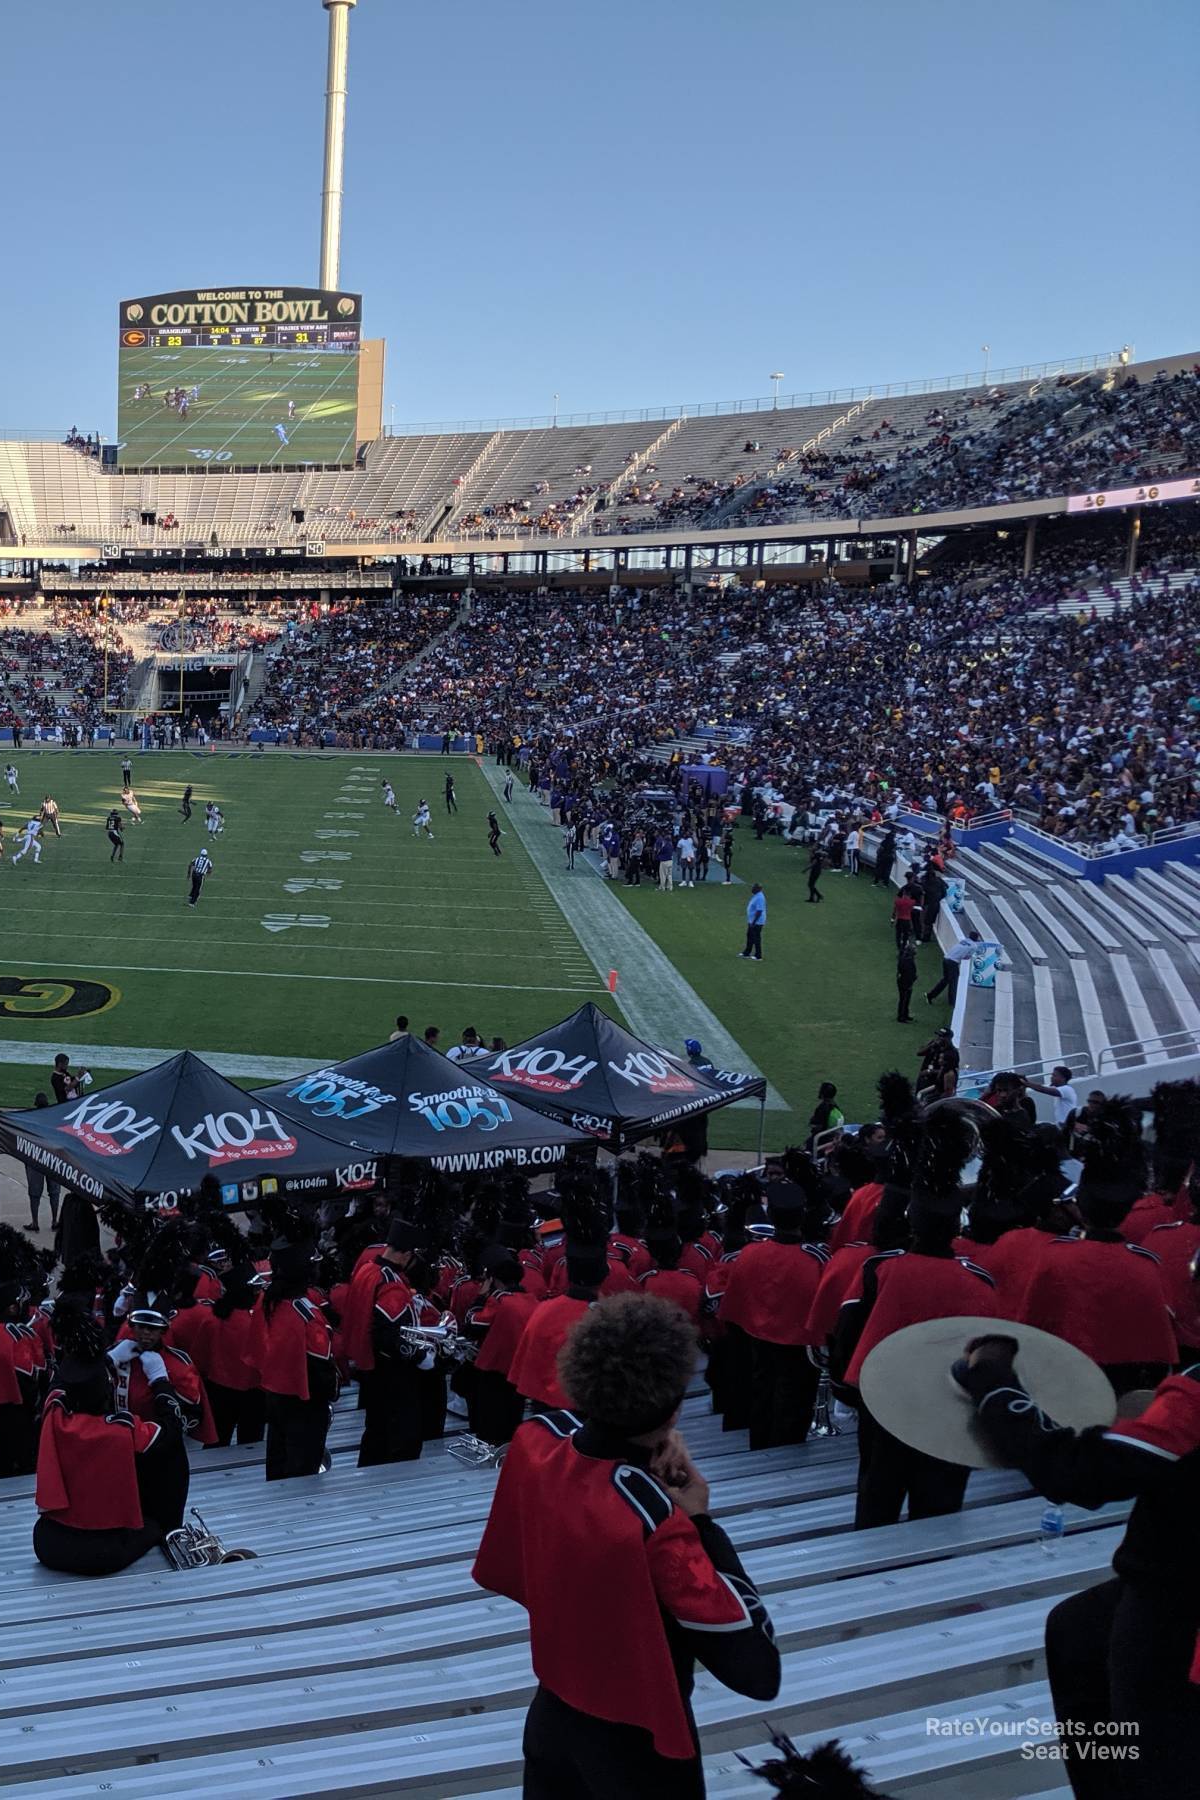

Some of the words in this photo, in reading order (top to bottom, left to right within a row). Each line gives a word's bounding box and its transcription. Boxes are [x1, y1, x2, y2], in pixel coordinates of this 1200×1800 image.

[197, 291, 246, 301] WELCOME
[249, 291, 262, 300] TO
[264, 290, 283, 299] THE
[151, 302, 251, 326] COTTON
[254, 300, 328, 323] BOWL
[167, 336, 182, 346] 23
[295, 333, 309, 343] 31
[104, 545, 119, 557] 40
[265, 548, 276, 556] 23
[308, 543, 323, 555] 40
[488, 1047, 598, 1084] K104
[64, 1094, 160, 1150] K104
[171, 1108, 290, 1159] K104
[16, 1135, 104, 1199] WWW.MYK104.COM
[285, 1177, 328, 1192] @k104fm
[336, 1161, 377, 1188] K104
[99, 1782, 114, 1791] 20
